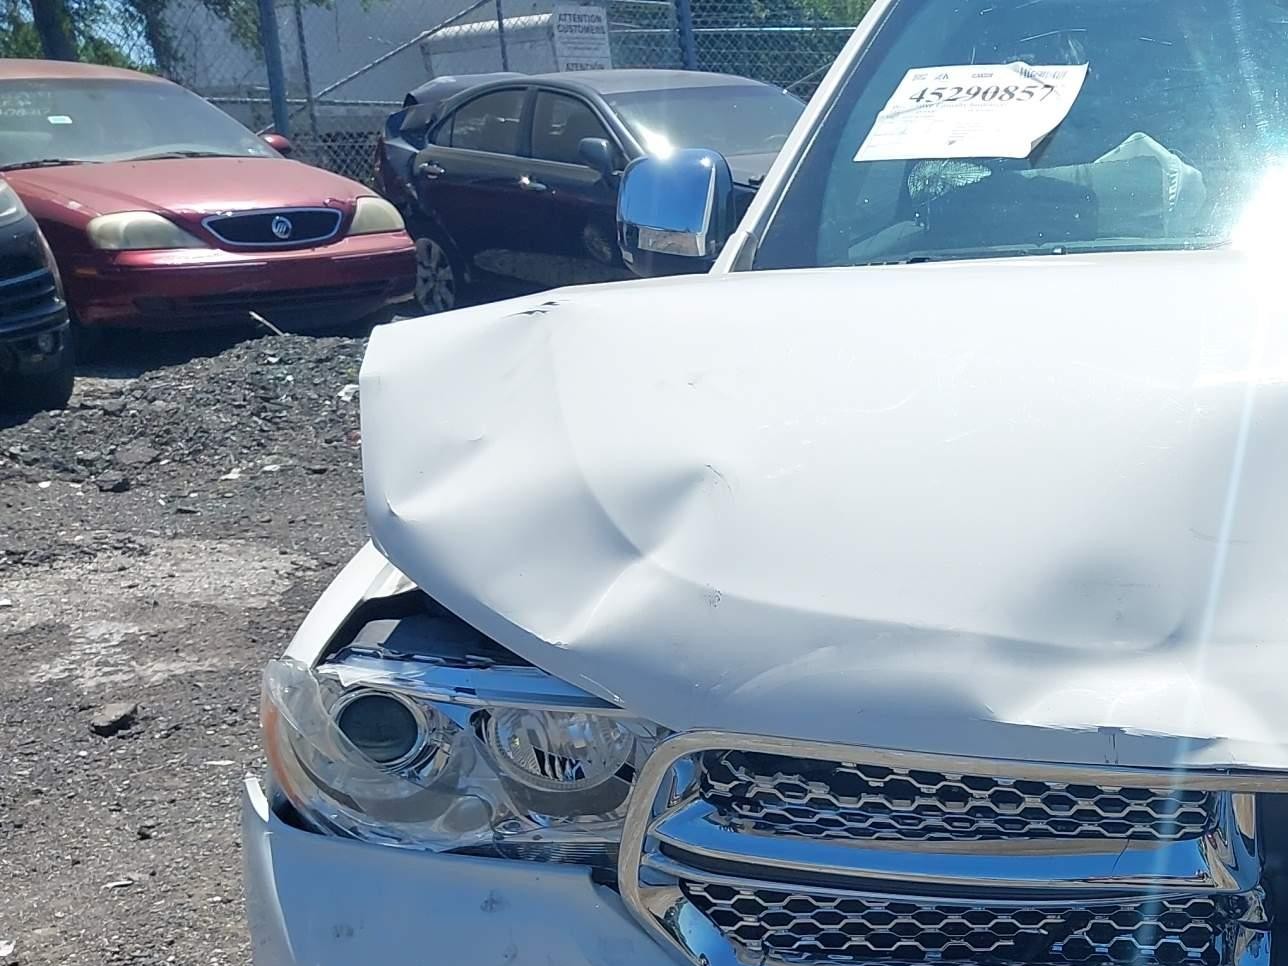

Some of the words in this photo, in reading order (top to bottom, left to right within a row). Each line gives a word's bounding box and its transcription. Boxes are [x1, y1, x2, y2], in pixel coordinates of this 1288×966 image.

[558, 13, 602, 23] ATTENTION
[557, 24, 606, 35] CUSTOMERS
[909, 85, 1055, 103] 45290857
